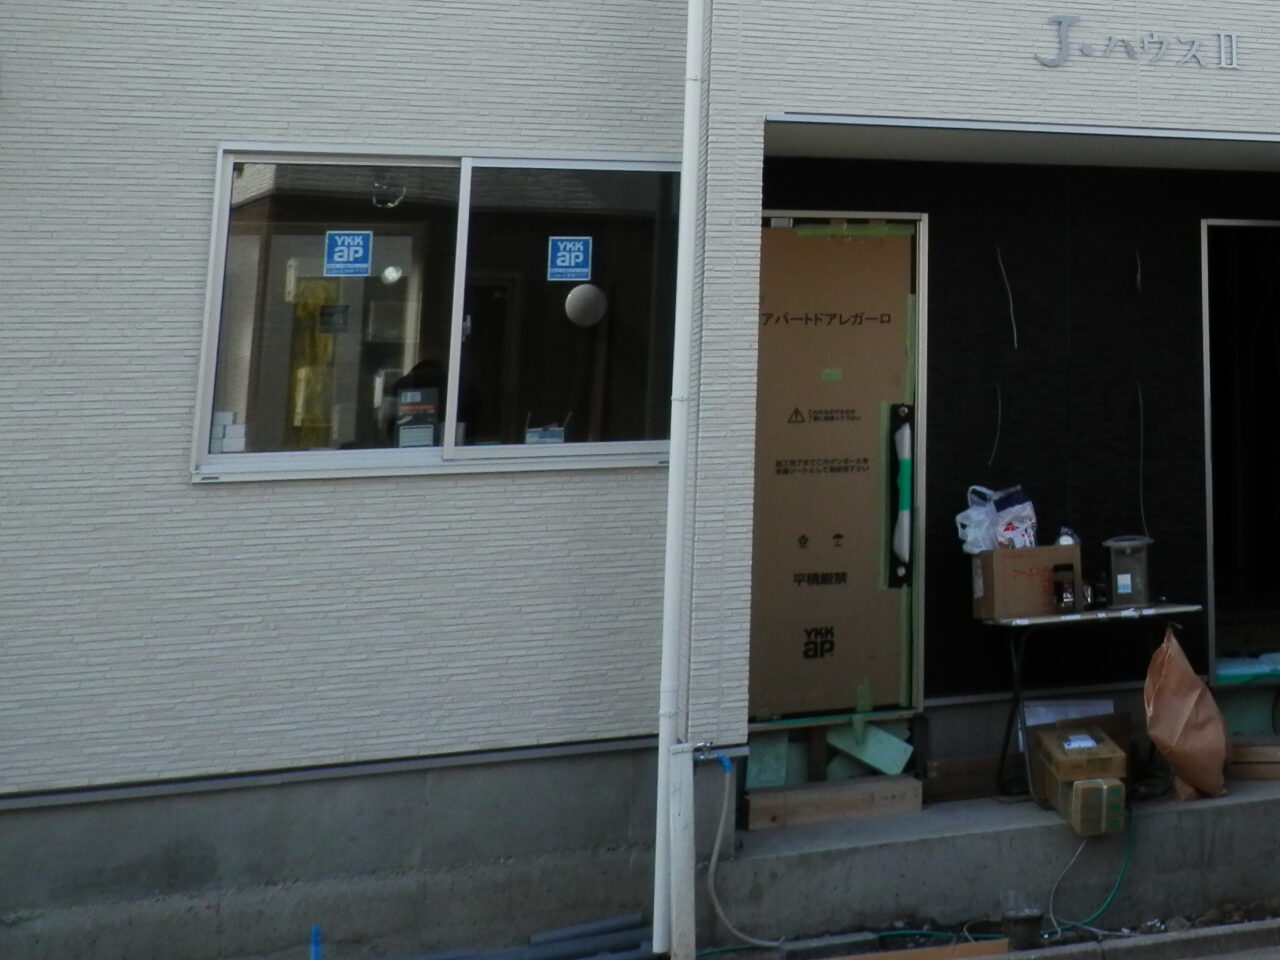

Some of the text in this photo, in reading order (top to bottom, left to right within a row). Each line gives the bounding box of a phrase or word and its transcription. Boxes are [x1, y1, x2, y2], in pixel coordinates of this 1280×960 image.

[335, 236, 363, 246] YKK
[557, 241, 584, 251] YKK
[804, 626, 834, 639] YKK
